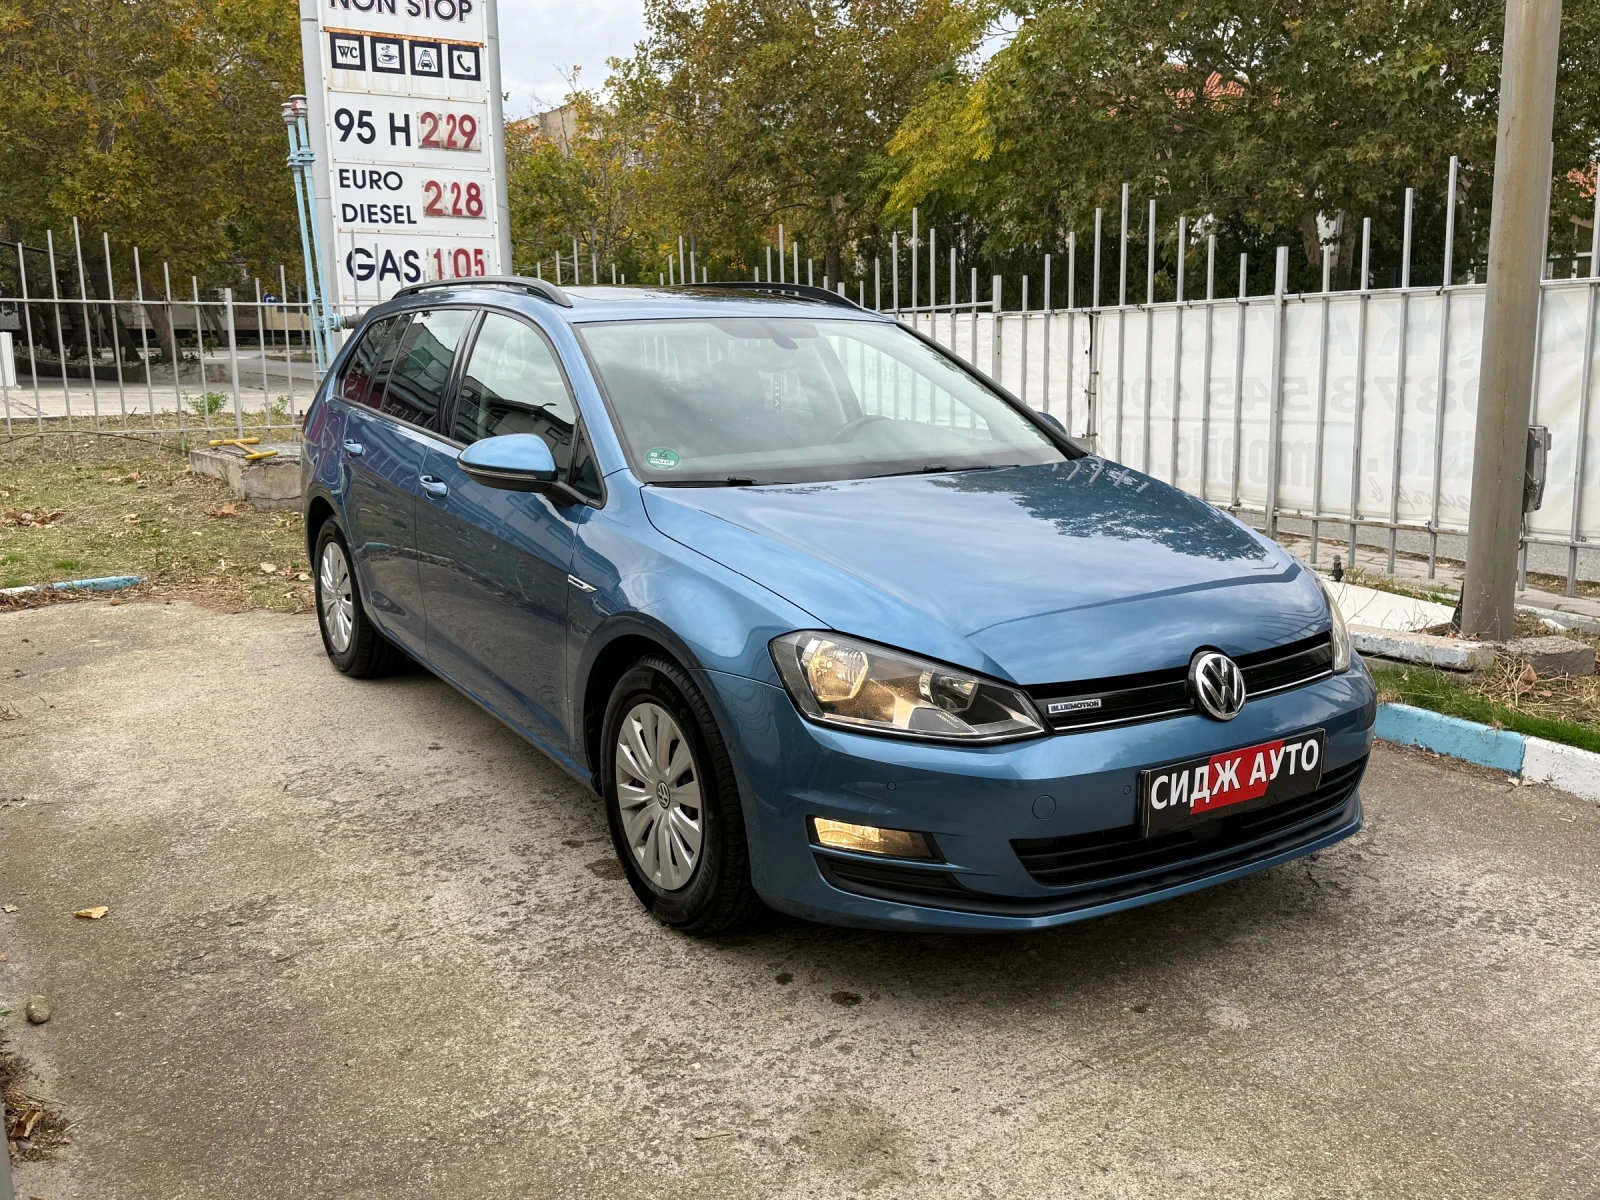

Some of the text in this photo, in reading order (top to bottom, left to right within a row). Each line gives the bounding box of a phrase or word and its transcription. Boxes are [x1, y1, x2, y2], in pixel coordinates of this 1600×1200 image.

[406, 0, 473, 22] STOP
[337, 45, 359, 59] WC
[334, 107, 376, 145] 95
[420, 111, 477, 149] 229
[339, 169, 403, 191] EURO
[424, 180, 483, 217] 228
[342, 203, 417, 224] DIESEL
[346, 247, 485, 283] GAS 105
[1050, 700, 1100, 712] BLUEMOTION
[1151, 739, 1319, 810] СИДЖ АУТО
